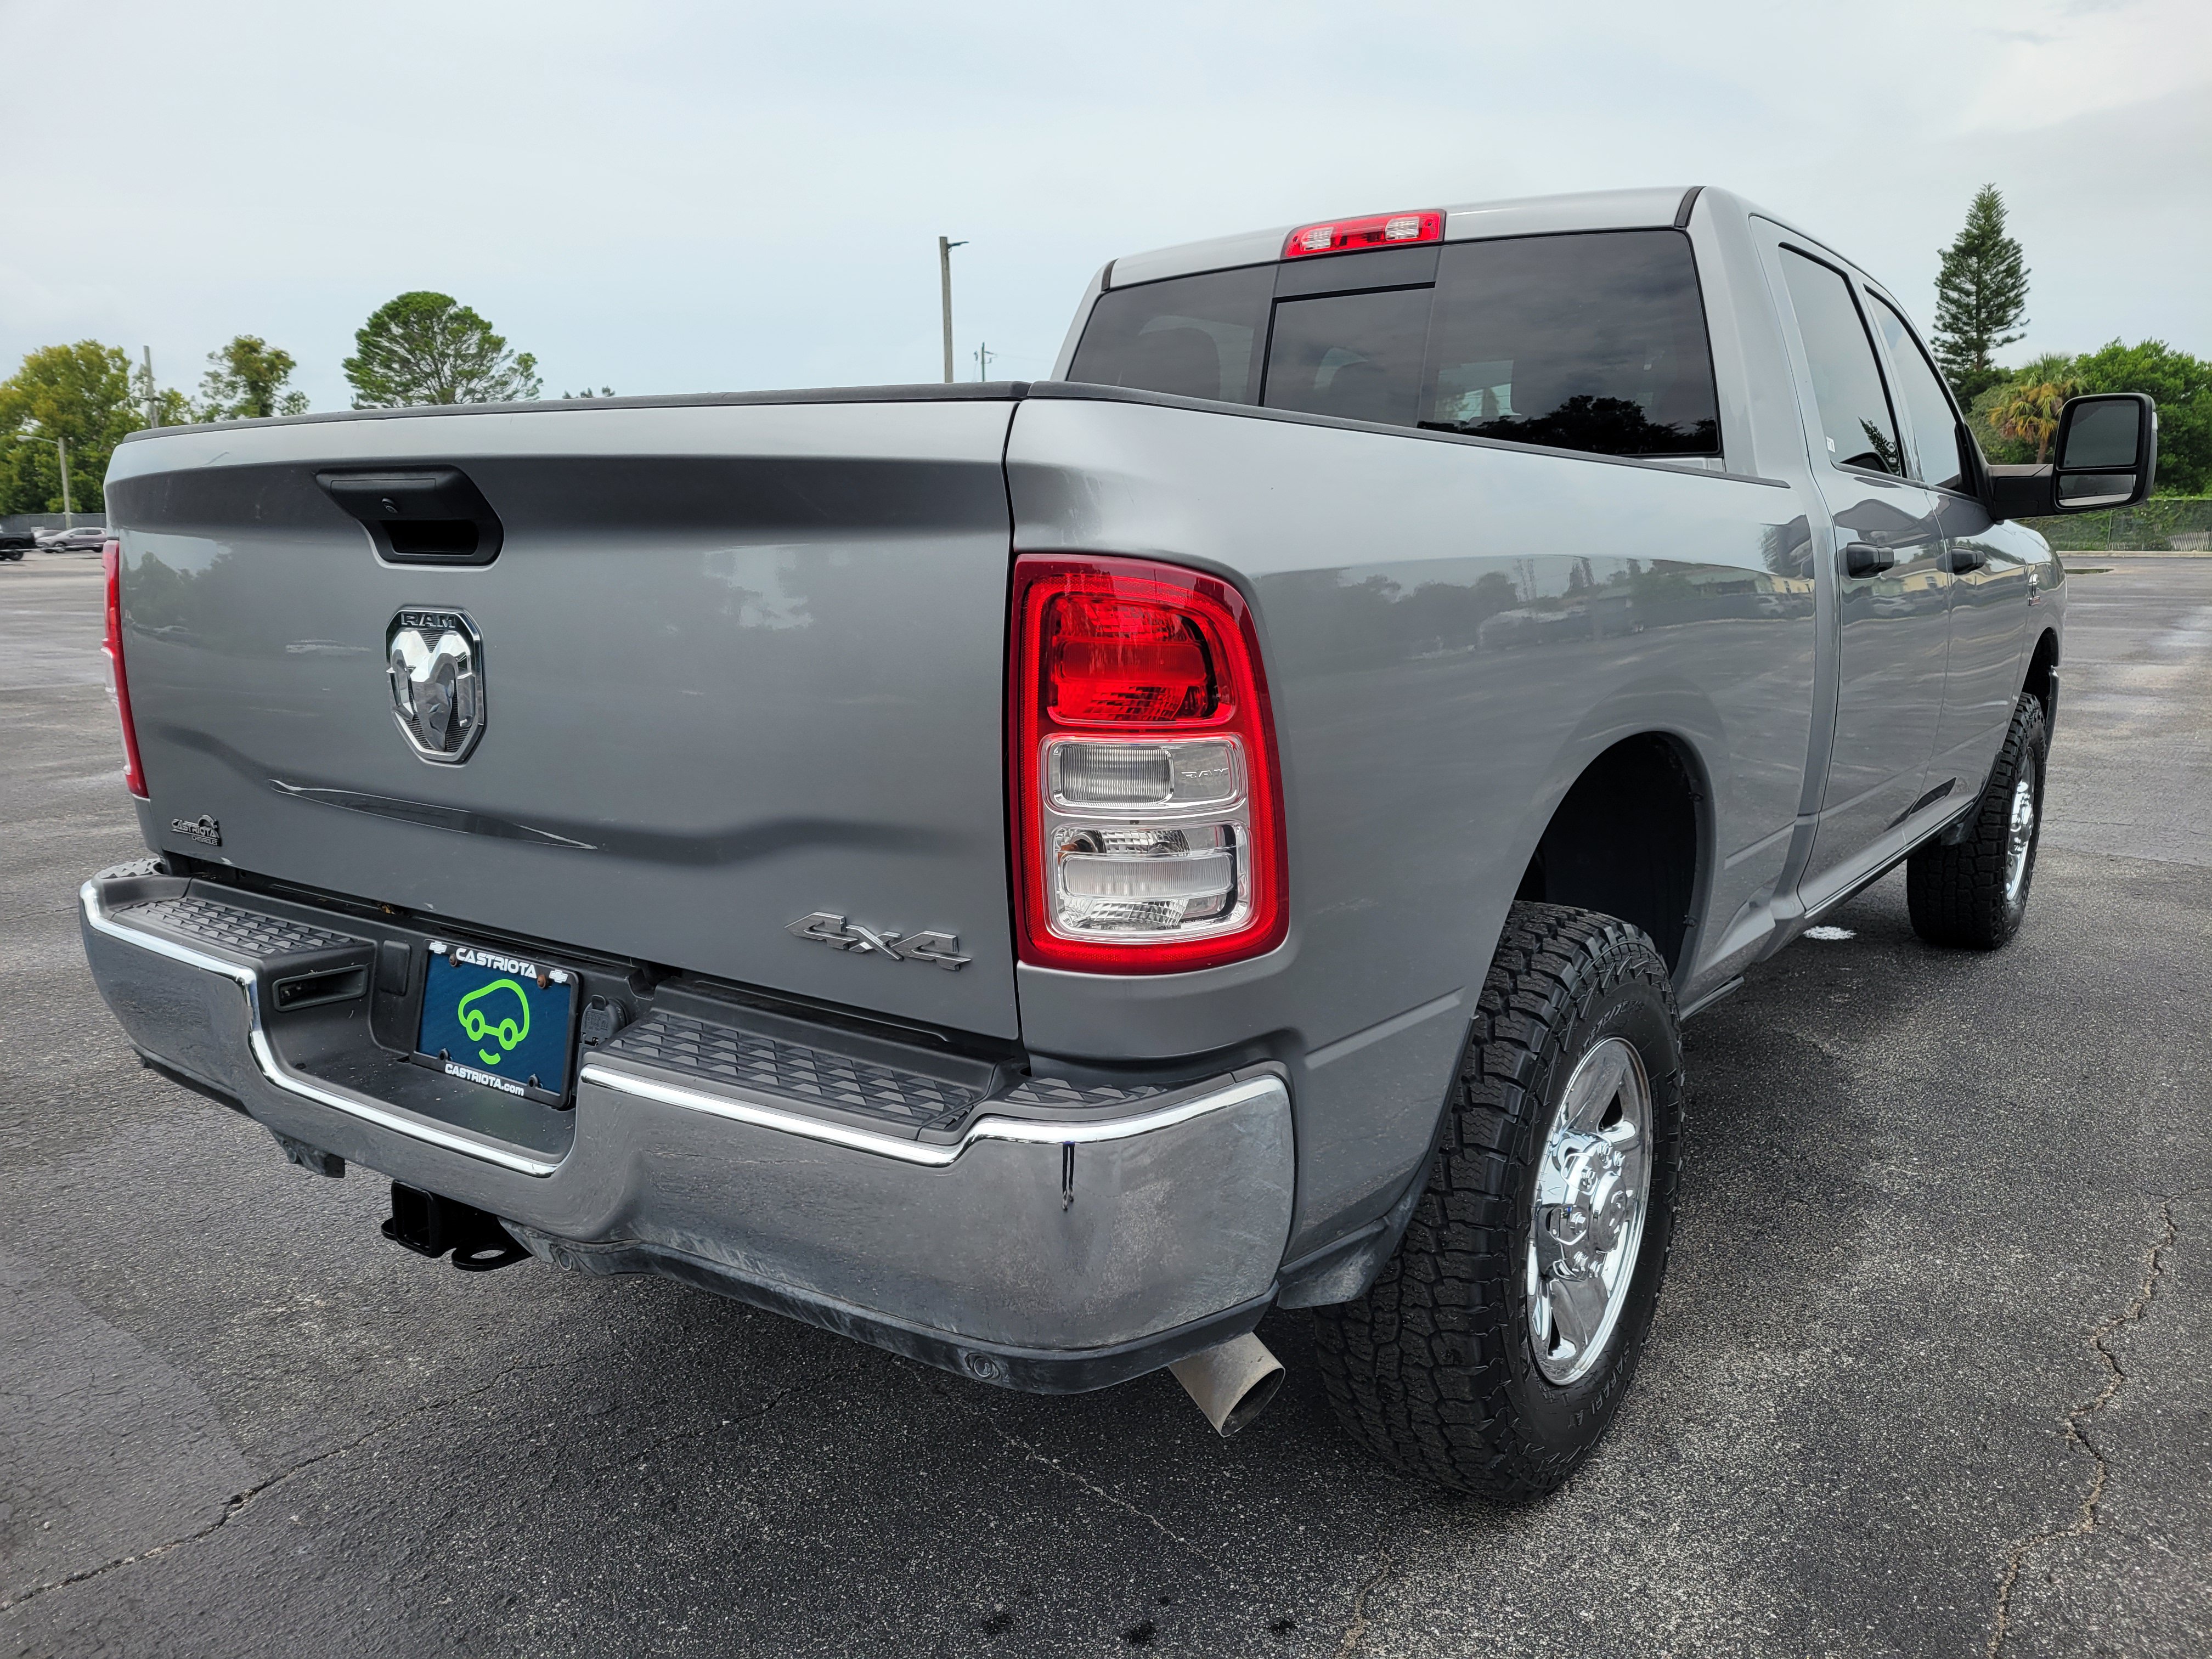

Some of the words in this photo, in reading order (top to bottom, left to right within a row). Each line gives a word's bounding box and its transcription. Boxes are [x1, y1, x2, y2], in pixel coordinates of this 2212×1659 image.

[400, 613, 456, 628] RAM
[171, 819, 219, 838] CASTRIOTA
[455, 947, 538, 979] CASTRIOTA
[444, 1063, 524, 1096] CASTRIOTA.com
